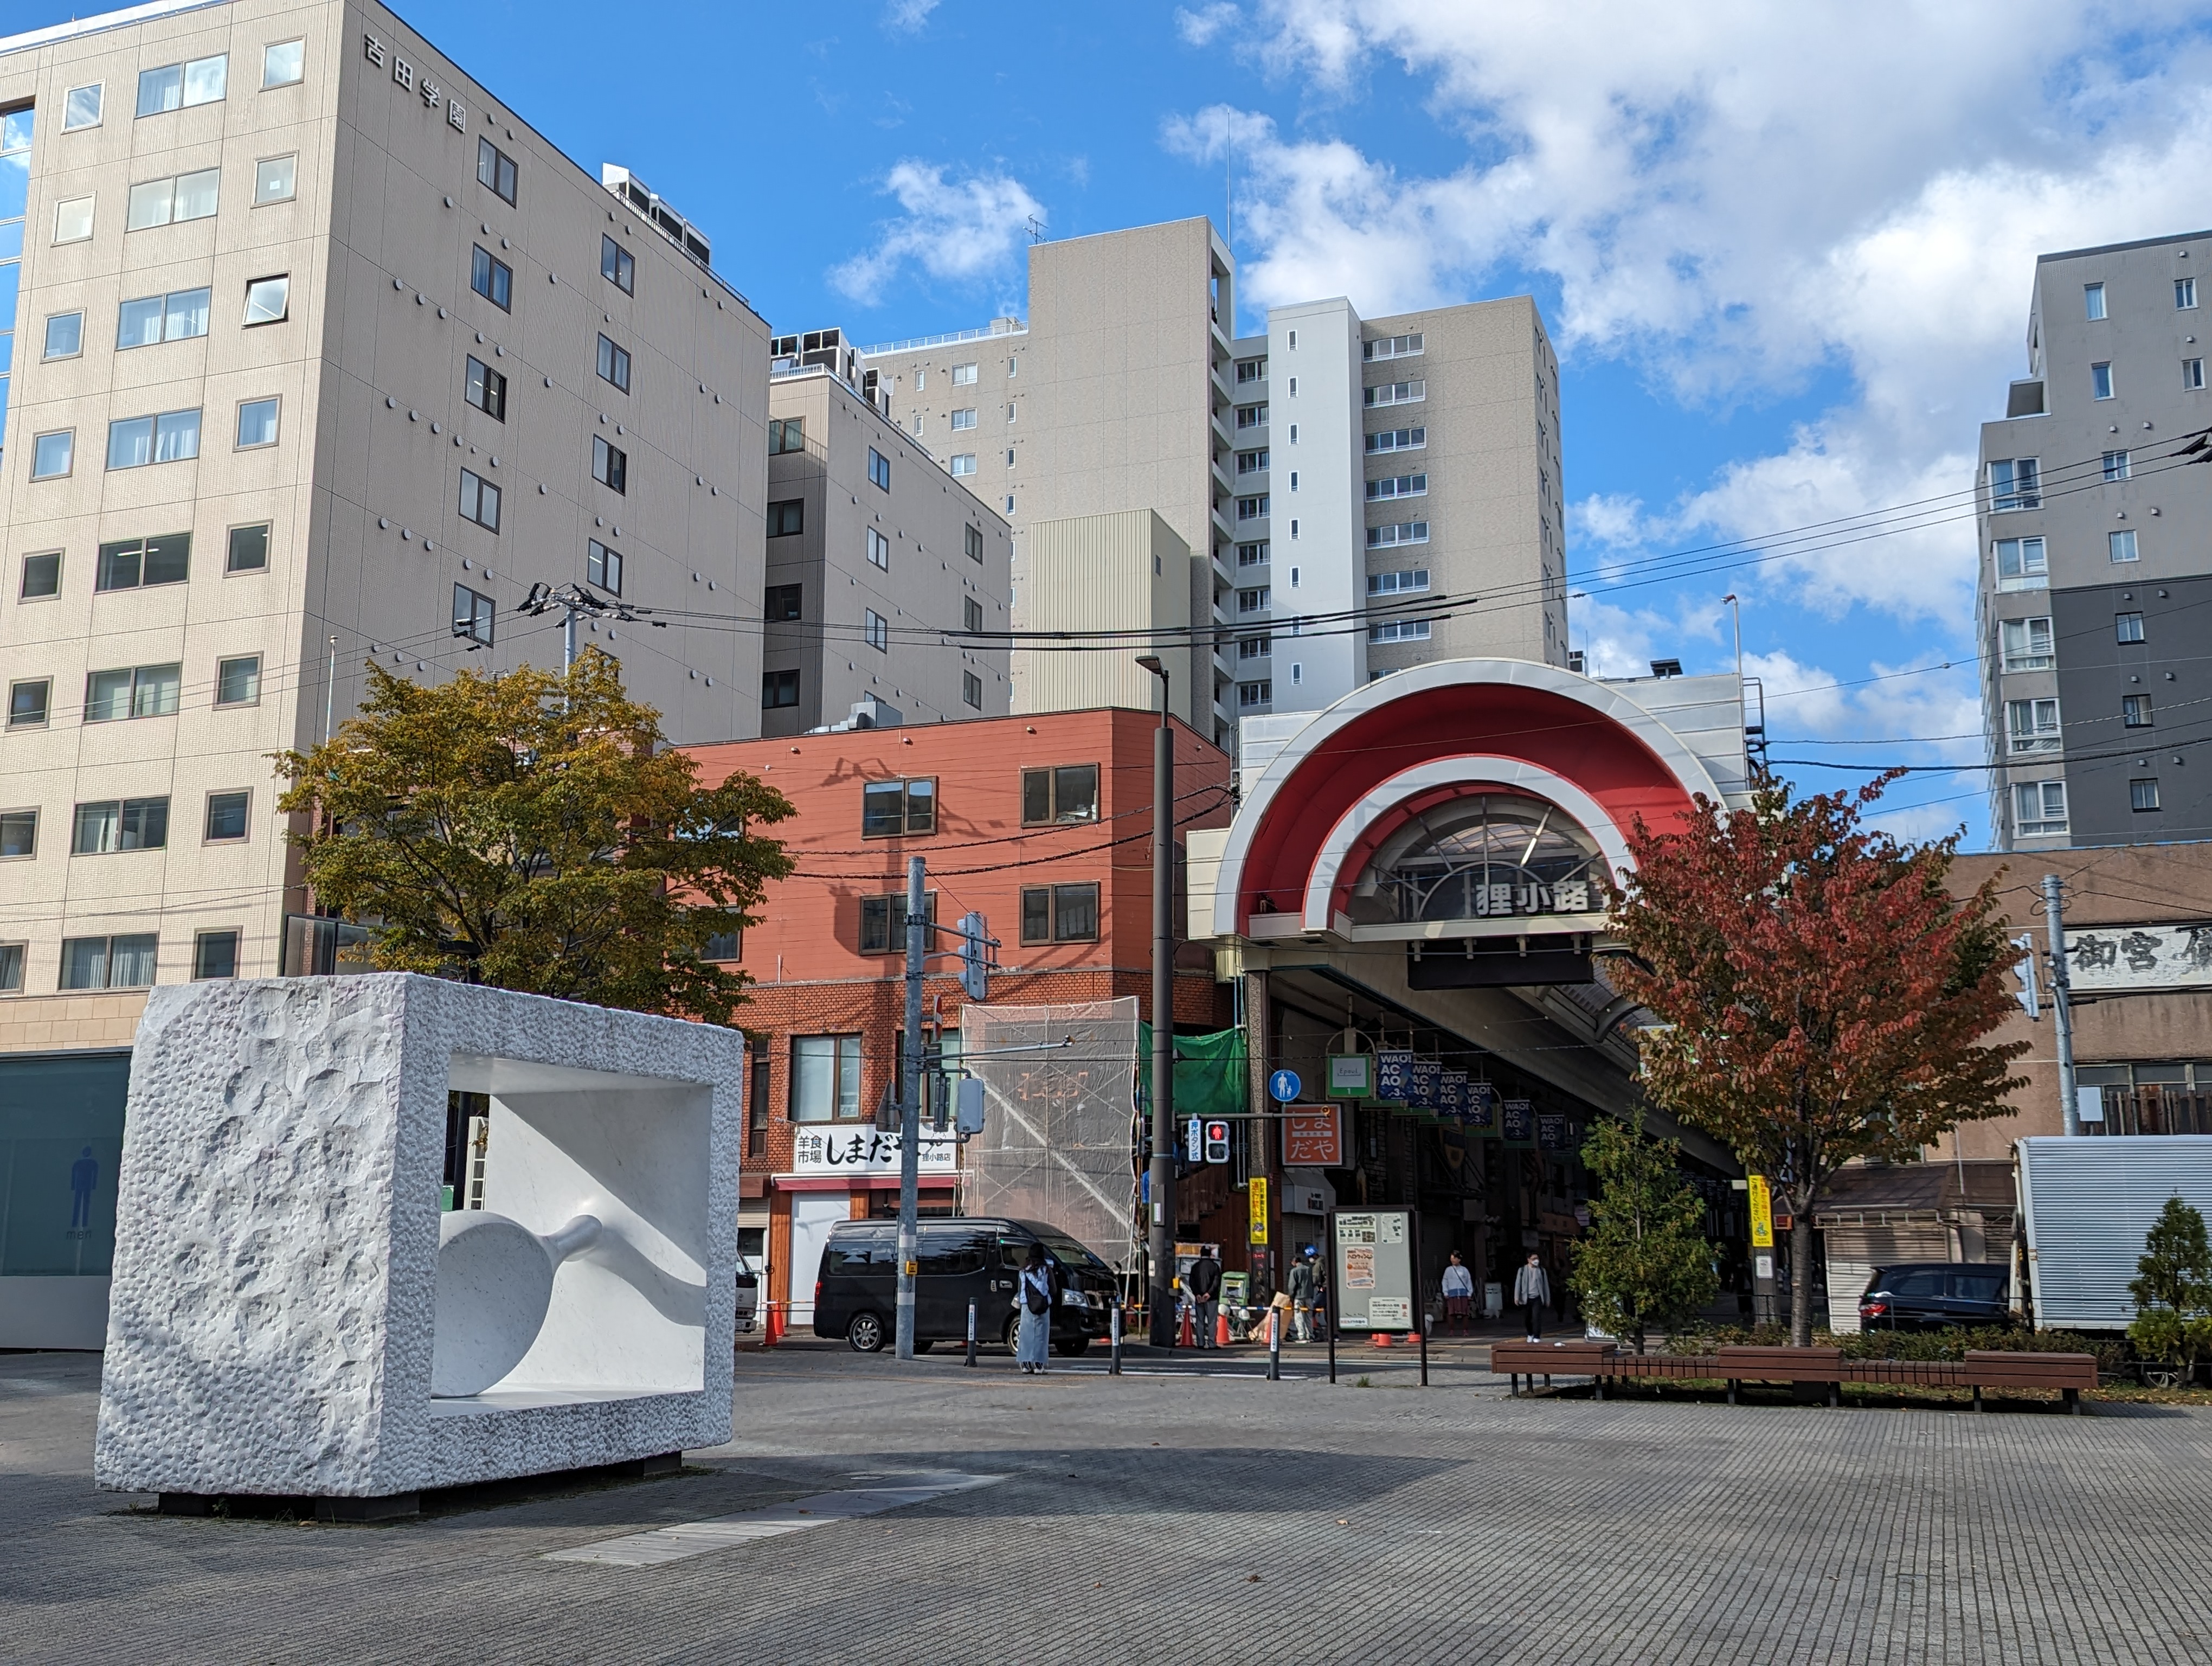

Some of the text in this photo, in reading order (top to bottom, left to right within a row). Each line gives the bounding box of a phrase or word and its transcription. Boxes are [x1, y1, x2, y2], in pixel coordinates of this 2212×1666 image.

[365, 33, 466, 133] 吉田学園
[1476, 881, 1609, 915] 狸小路
[1380, 1055, 1412, 1063] WAO!
[1380, 1065, 1400, 1074] AC
[1412, 1065, 1441, 1074] WAO!
[1380, 1075, 1401, 1086] AO
[1504, 1103, 1529, 1111] WAO!
[1505, 1111, 1520, 1119] AC
[1505, 1119, 1520, 1128] AO
[798, 1136, 822, 1149] 羊食
[1191, 1122, 1199, 1160] 押ボタン式
[1290, 1140, 1334, 1161] だや
[798, 1150, 822, 1164] 市場
[922, 1153, 951, 1162] 狸小路店
[66, 1231, 92, 1240] men
